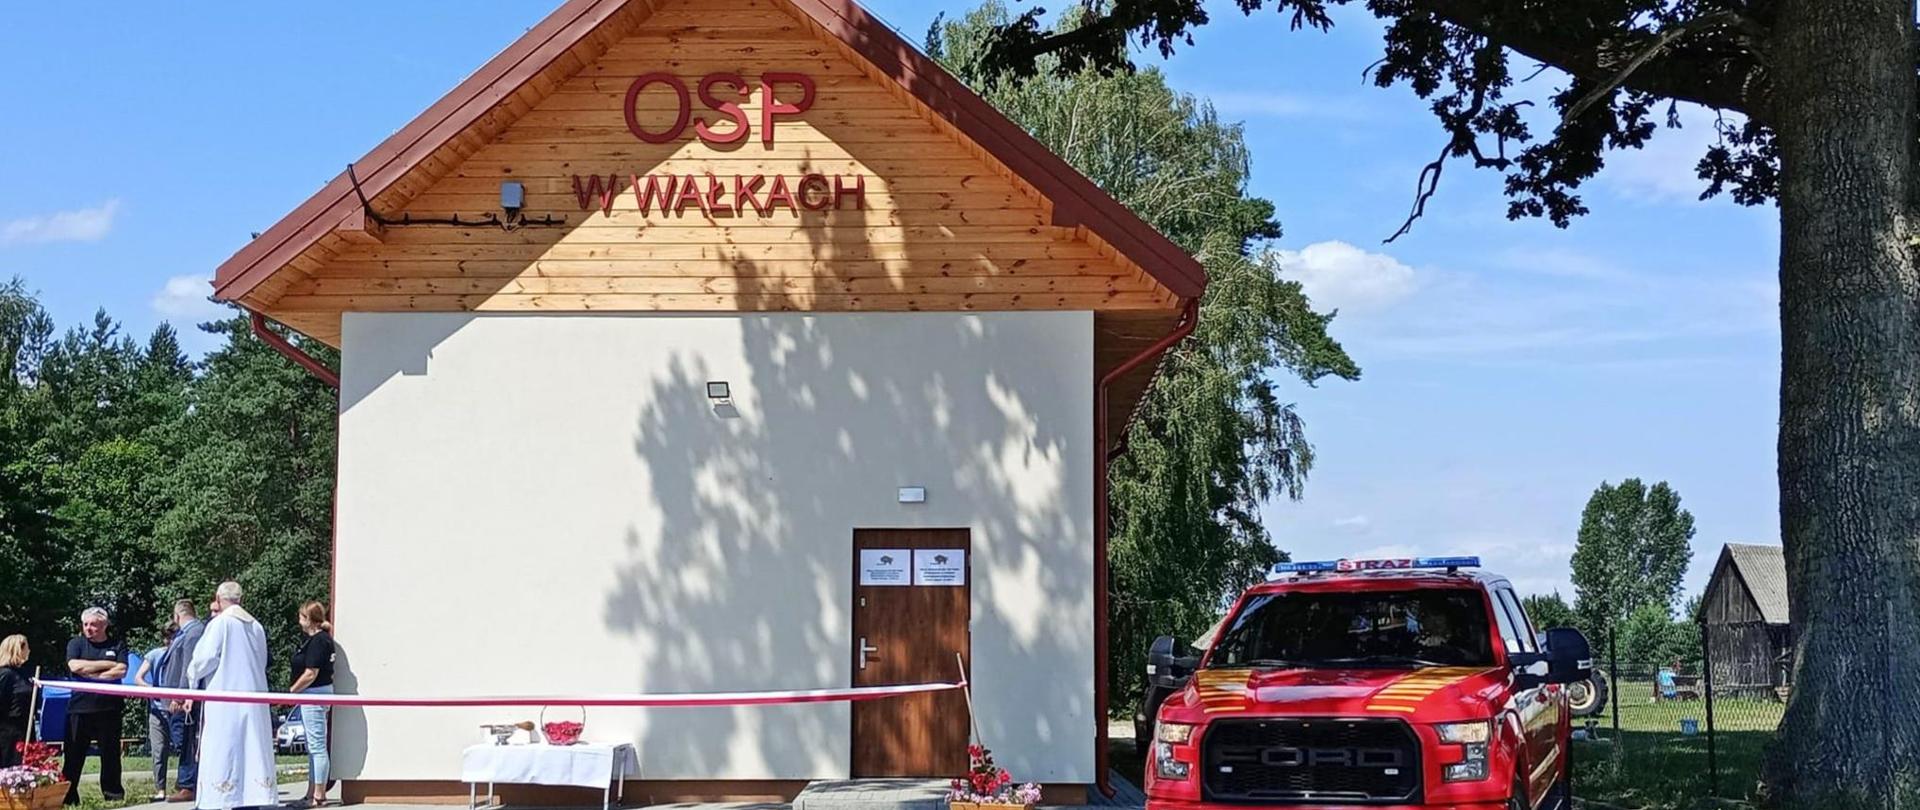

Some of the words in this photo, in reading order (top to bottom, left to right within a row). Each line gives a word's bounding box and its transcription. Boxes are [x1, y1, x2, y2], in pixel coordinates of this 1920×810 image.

[624, 72, 816, 144] OSP
[572, 173, 616, 216] W
[630, 171, 866, 218] WAŁKACH
[1218, 746, 1404, 768] FORD
